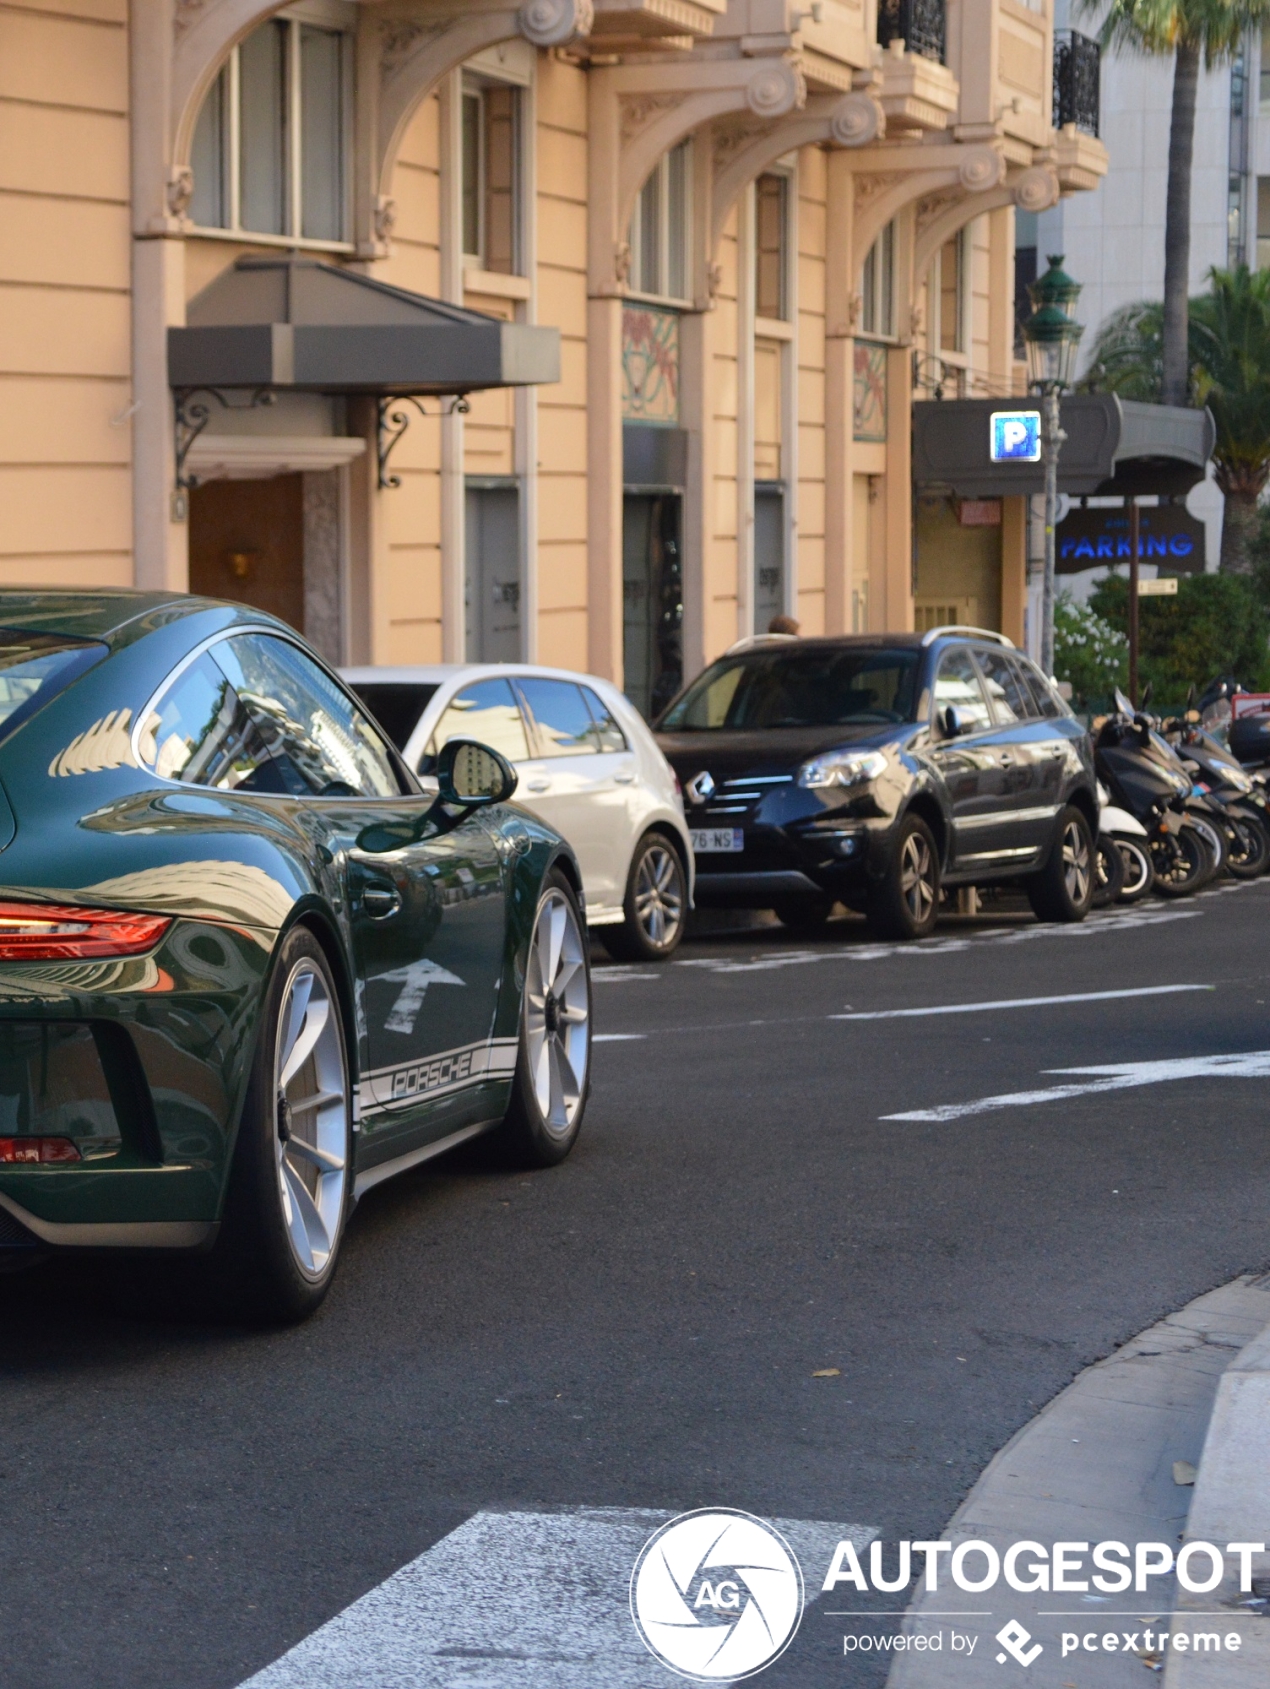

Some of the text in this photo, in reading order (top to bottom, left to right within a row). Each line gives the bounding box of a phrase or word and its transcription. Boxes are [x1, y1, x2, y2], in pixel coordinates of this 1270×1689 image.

[1003, 421, 1027, 453] P
[1061, 533, 1194, 559] PARKING
[394, 1052, 471, 1099] PORSCHE
